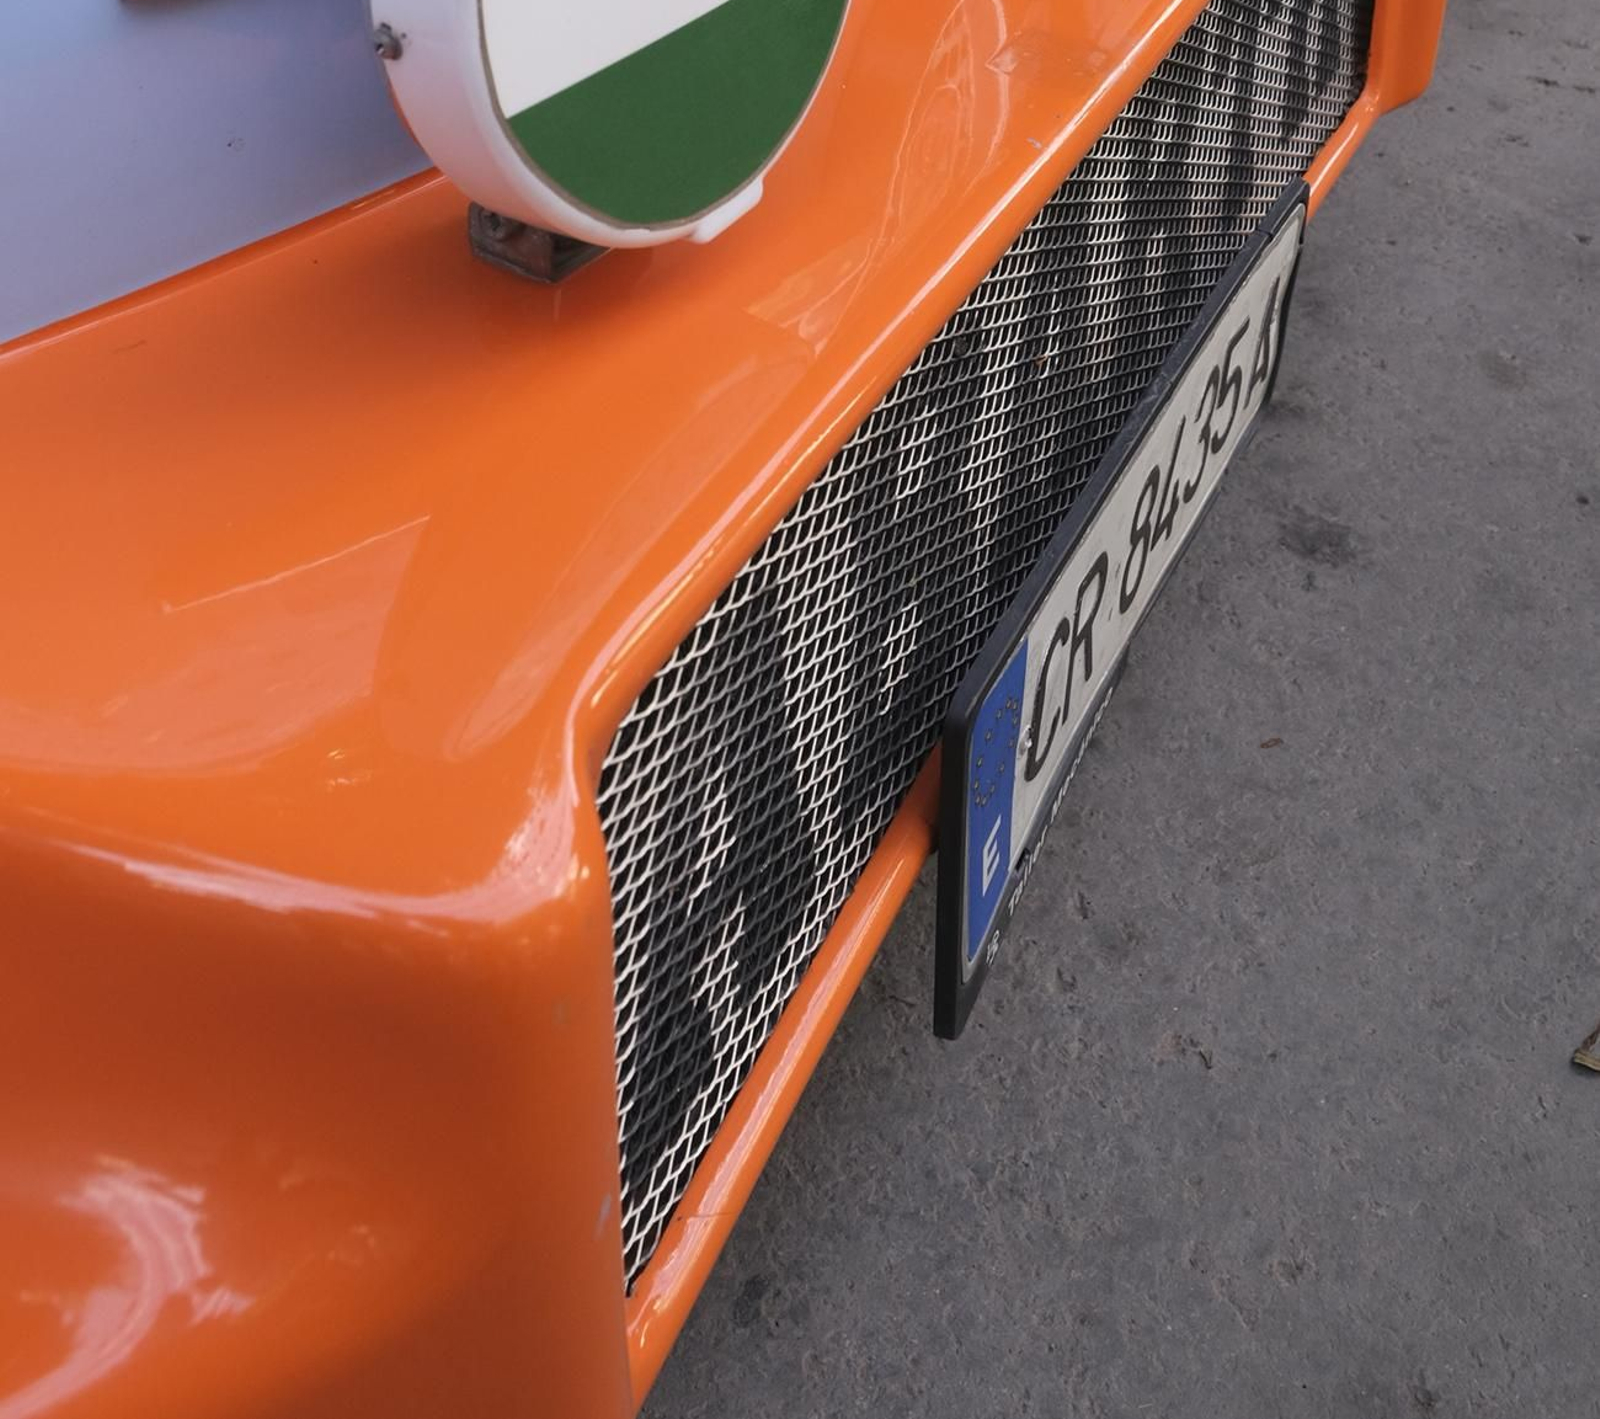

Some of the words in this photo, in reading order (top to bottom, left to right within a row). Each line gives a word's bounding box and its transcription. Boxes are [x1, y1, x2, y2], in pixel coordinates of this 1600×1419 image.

[1023, 550, 1108, 782] CR
[1119, 314, 1250, 615] 8435
[982, 813, 1002, 898] E
